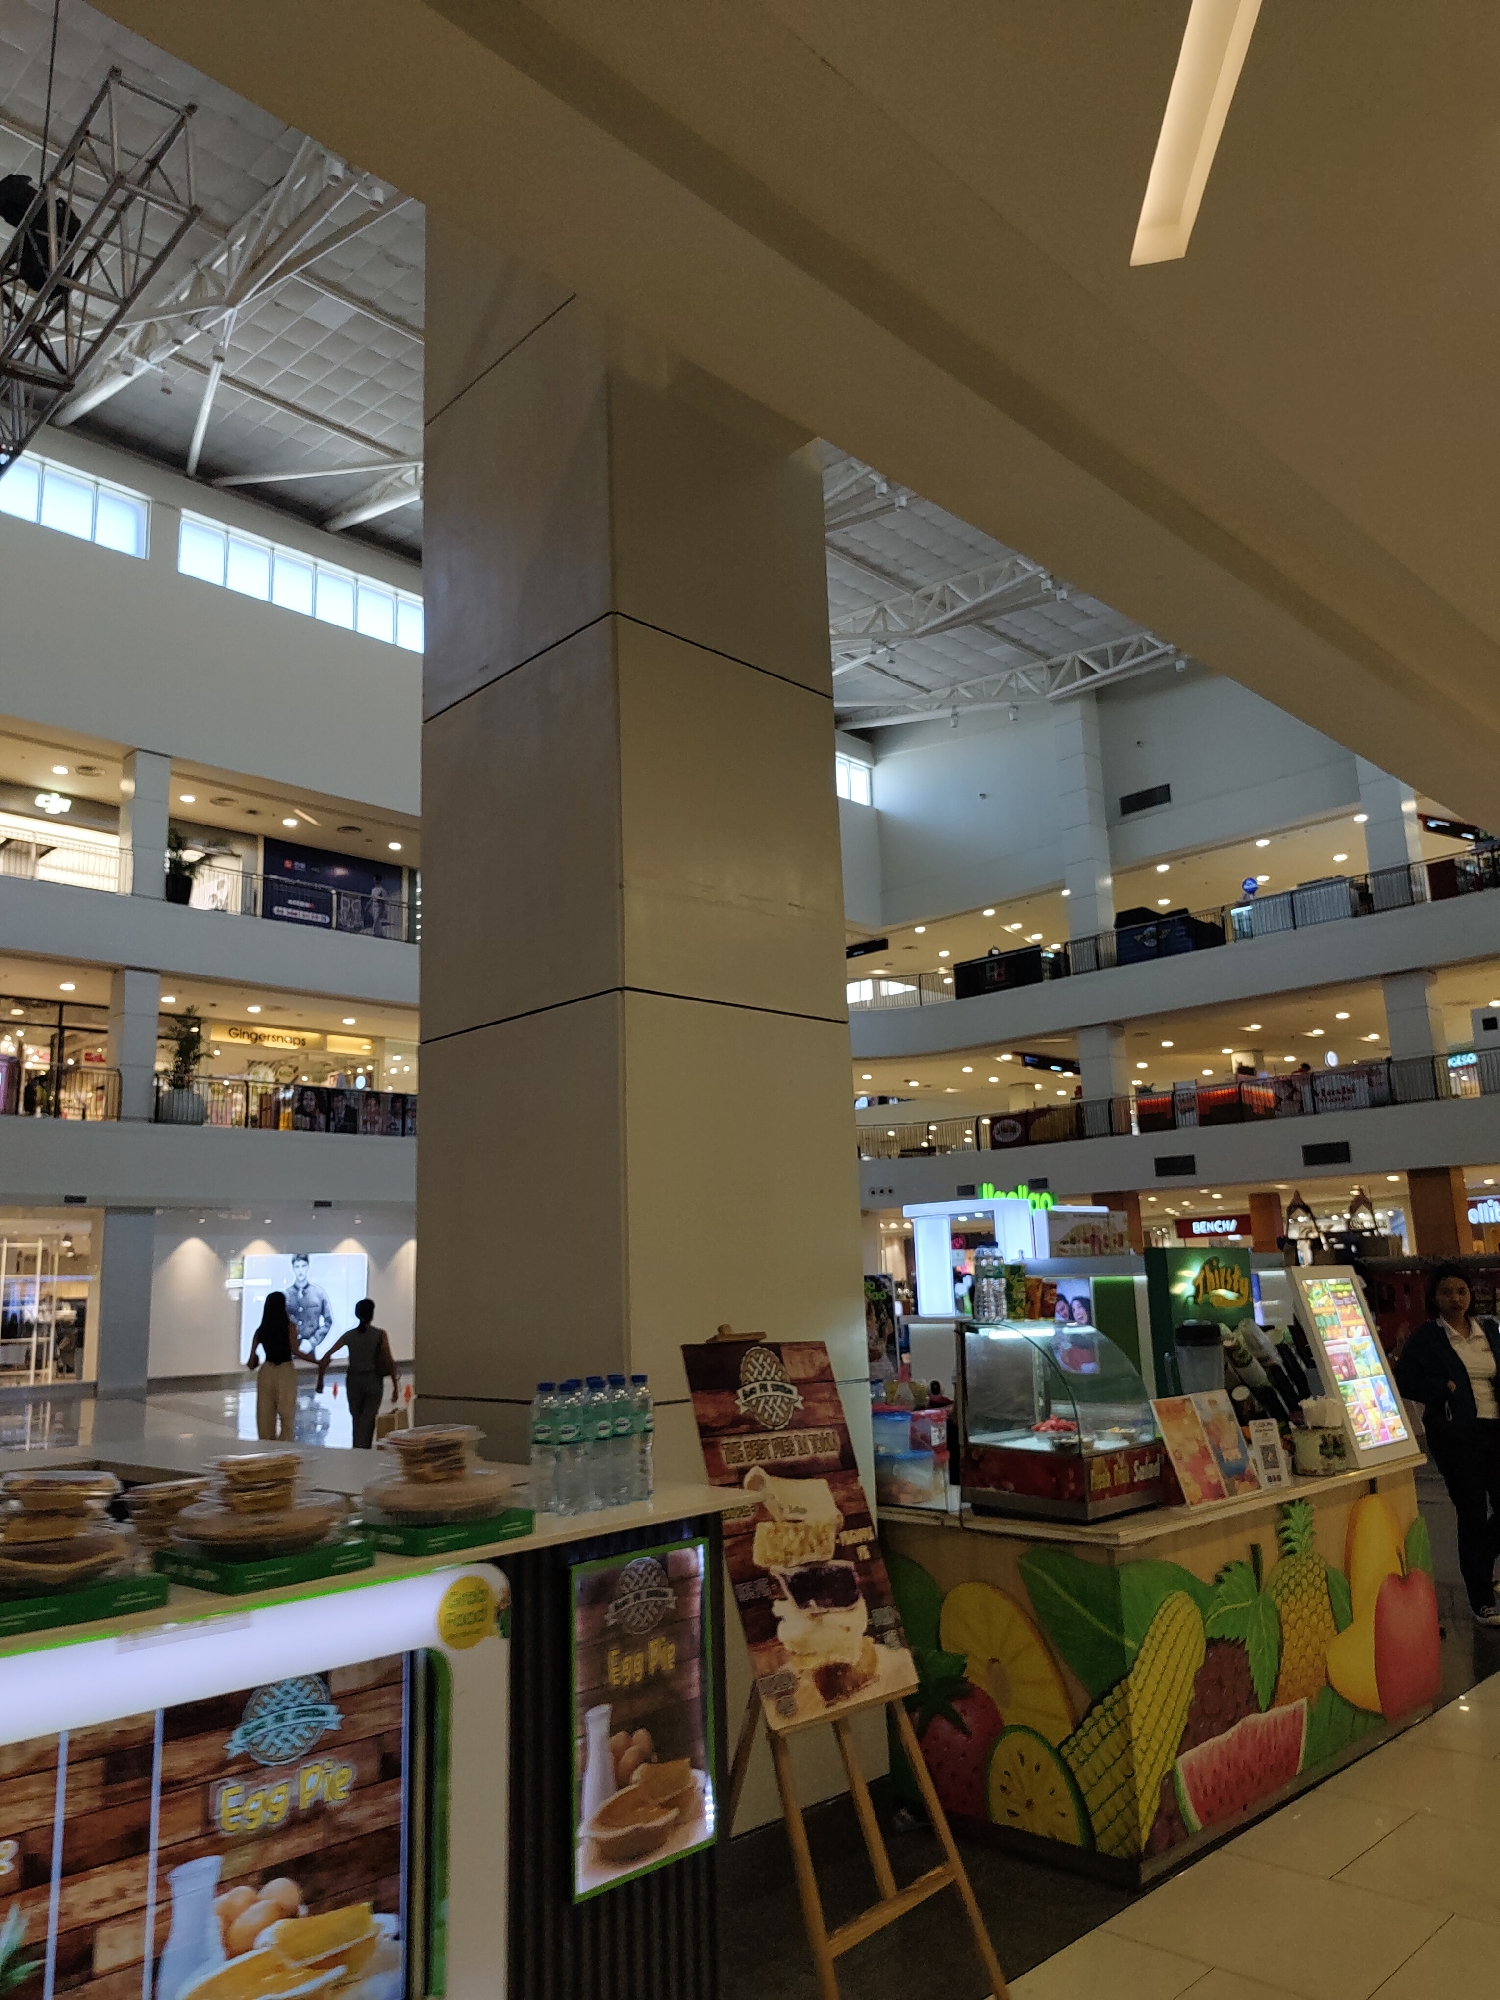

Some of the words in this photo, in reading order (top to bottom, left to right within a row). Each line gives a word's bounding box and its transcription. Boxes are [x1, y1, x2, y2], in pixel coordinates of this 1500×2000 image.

[228, 1027, 306, 1047] Gingersnaps
[1193, 1257, 1250, 1308] Thirsty
[721, 1441, 745, 1464] THE
[743, 1438, 771, 1462] BEST
[770, 1435, 796, 1459] PIES
[809, 1431, 840, 1454] TOWN
[608, 1649, 645, 1687] Egg
[647, 1637, 676, 1675] Pie
[221, 1782, 290, 1832] Egg
[299, 1760, 353, 1810] Pie
